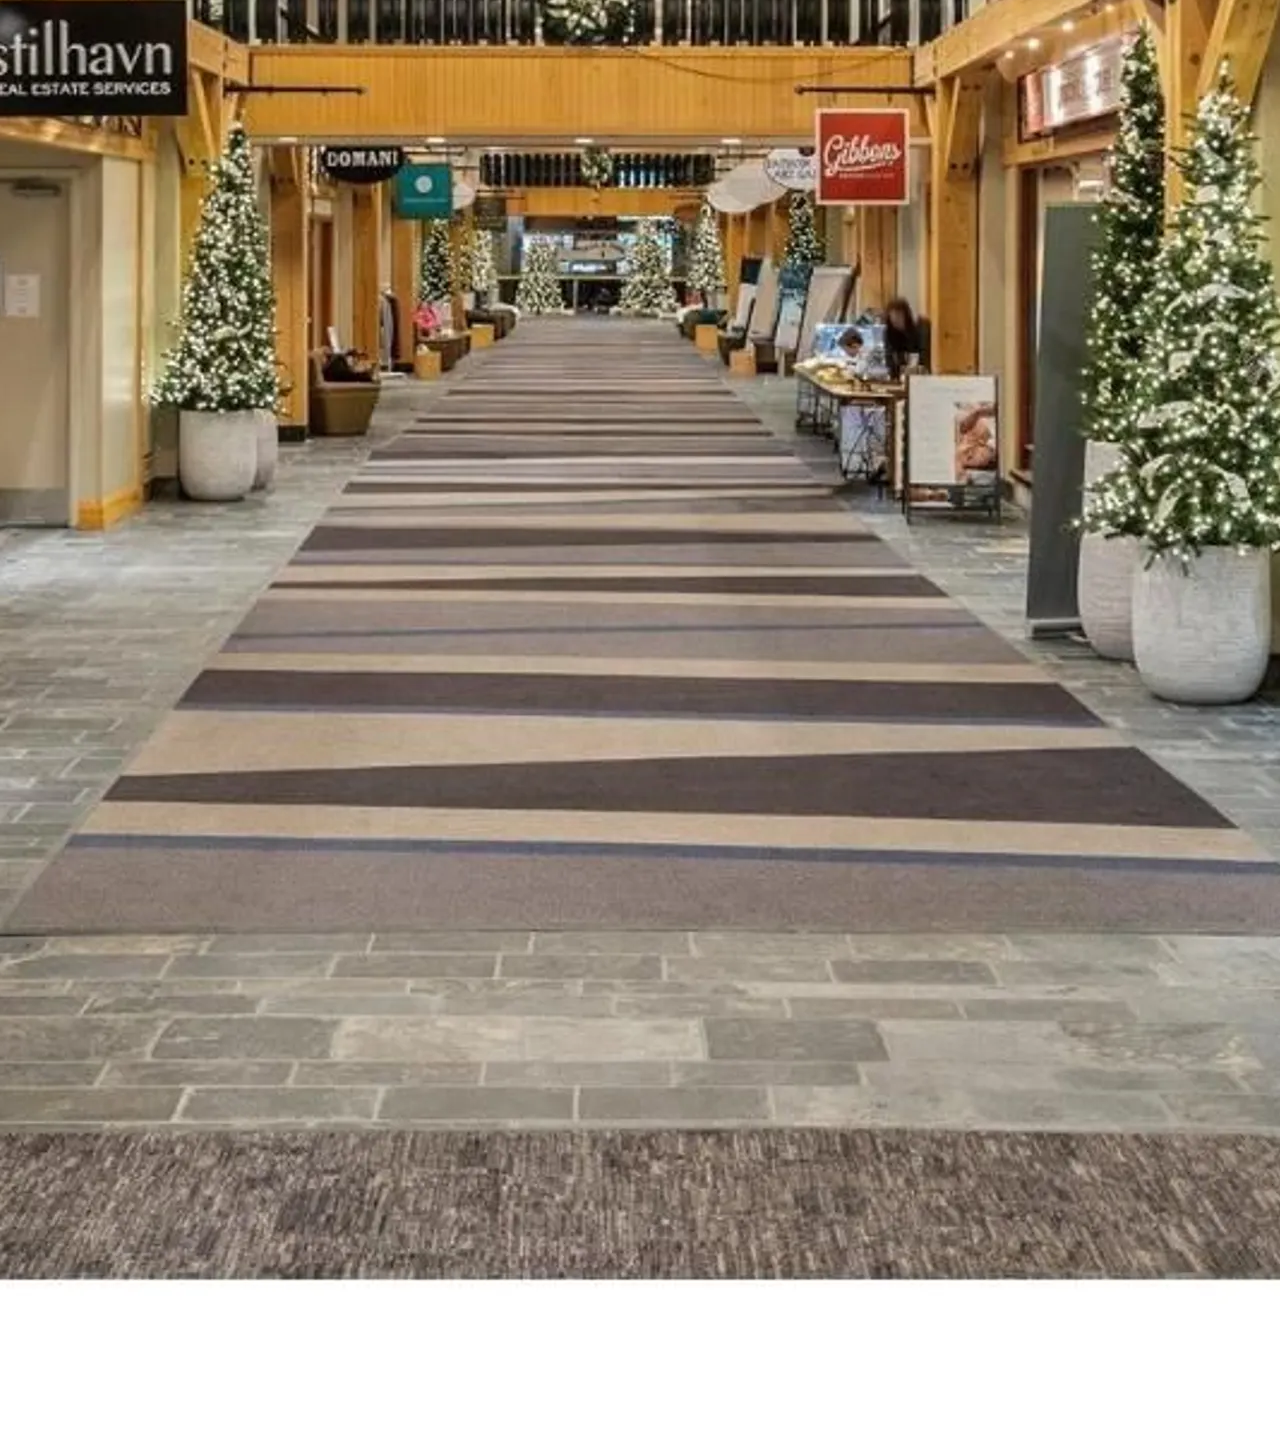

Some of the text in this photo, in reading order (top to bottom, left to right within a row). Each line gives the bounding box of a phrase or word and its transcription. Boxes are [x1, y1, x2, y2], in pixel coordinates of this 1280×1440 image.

[30, 82, 90, 96] ESTATE
[93, 81, 172, 95] SERVICES
[327, 151, 399, 167] DOMANI
[823, 134, 903, 177] Gibbons
